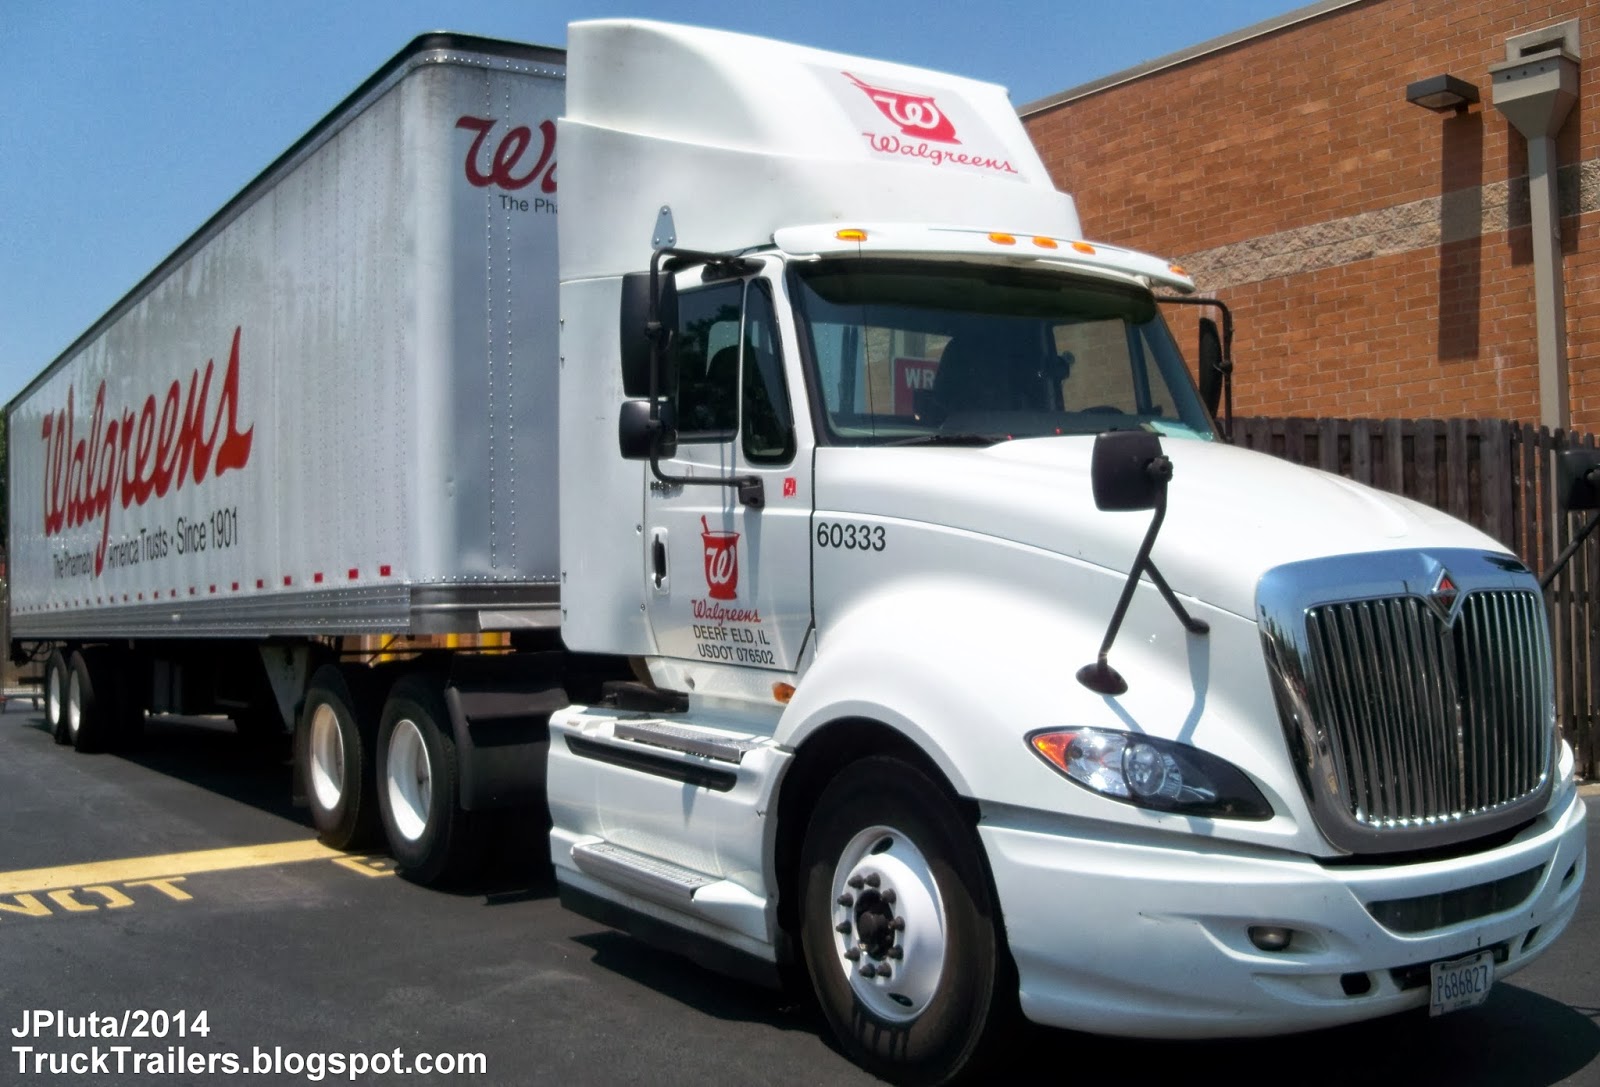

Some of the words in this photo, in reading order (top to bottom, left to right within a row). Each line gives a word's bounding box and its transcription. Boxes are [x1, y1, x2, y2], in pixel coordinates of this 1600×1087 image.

[862, 132, 1018, 174] Walgreens
[499, 195, 529, 212] The
[534, 198, 557, 214] Ph
[42, 325, 254, 577] Walgreens
[109, 533, 139, 569] America
[140, 526, 168, 562] Trusts
[177, 515, 207, 555] Since
[210, 506, 237, 549] 1901
[817, 522, 886, 552] 60333
[691, 599, 762, 627] Walgreens
[758, 629, 771, 646] IL
[698, 643, 734, 661] USDOT
[737, 648, 776, 665] 076502
